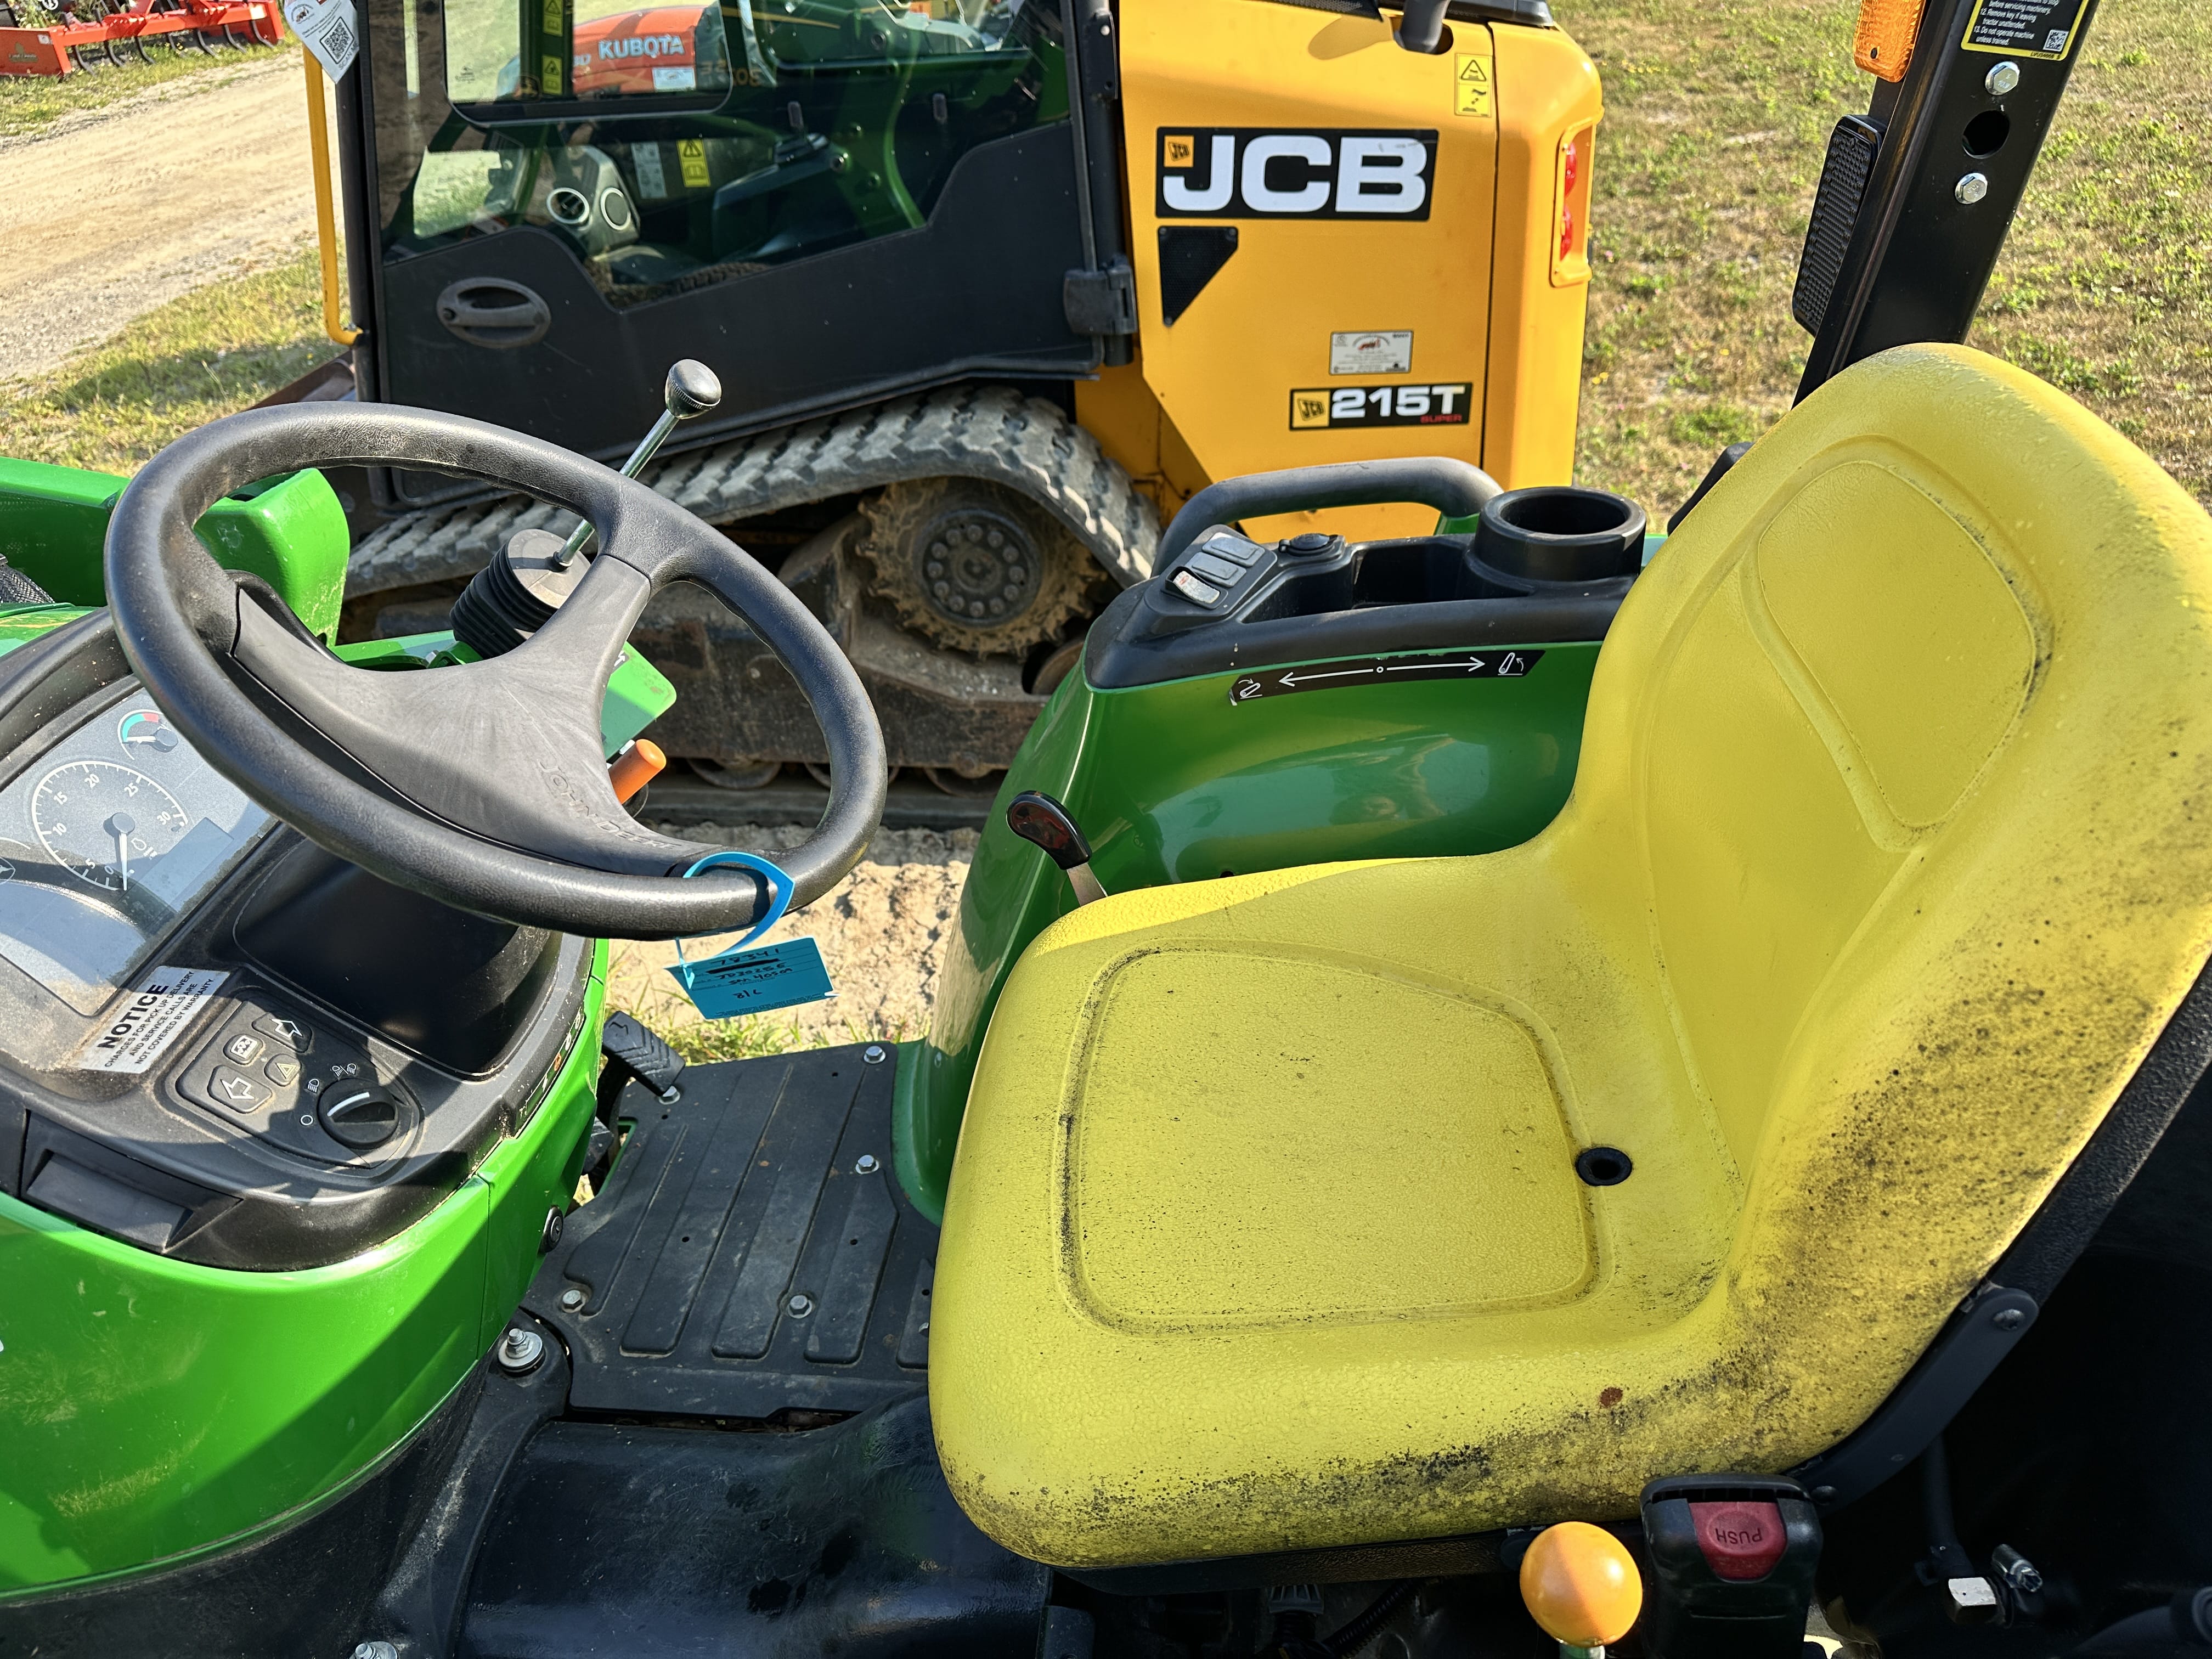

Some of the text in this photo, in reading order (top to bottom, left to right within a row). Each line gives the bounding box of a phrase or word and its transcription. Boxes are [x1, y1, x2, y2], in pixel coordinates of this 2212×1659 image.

[1987, 9, 2006, 18] Remove
[2006, 10, 2015, 20] key
[2019, 12, 2038, 23] leaving
[1996, 29, 2014, 38] operate
[2013, 31, 2035, 40] machine
[598, 35, 685, 61] KUBOTA
[1169, 141, 1192, 161] JCB
[1163, 134, 1428, 213] JCB
[1331, 384, 1466, 419] 215T
[1420, 414, 1463, 424] SUPER
[84, 773, 100, 788] 20
[124, 782, 139, 797] 25
[53, 791, 68, 805] 15
[537, 759, 682, 850] JOHN DEERE
[157, 810, 172, 825] 30
[53, 822, 67, 836] 10
[85, 857, 97, 870] 5
[104, 865, 115, 875] 0
[97, 984, 170, 1048] NOTICE
[104, 971, 195, 1068] CHARGES FOR PICK UP DELIVERY
[129, 983, 198, 1056] AND SERVICE CALLS ARE
[134, 1050, 151, 1064] NOT
[148, 1021, 177, 1050] COVERED
[173, 1012, 185, 1020] BY
[1715, 1527, 1763, 1545] PUSH
